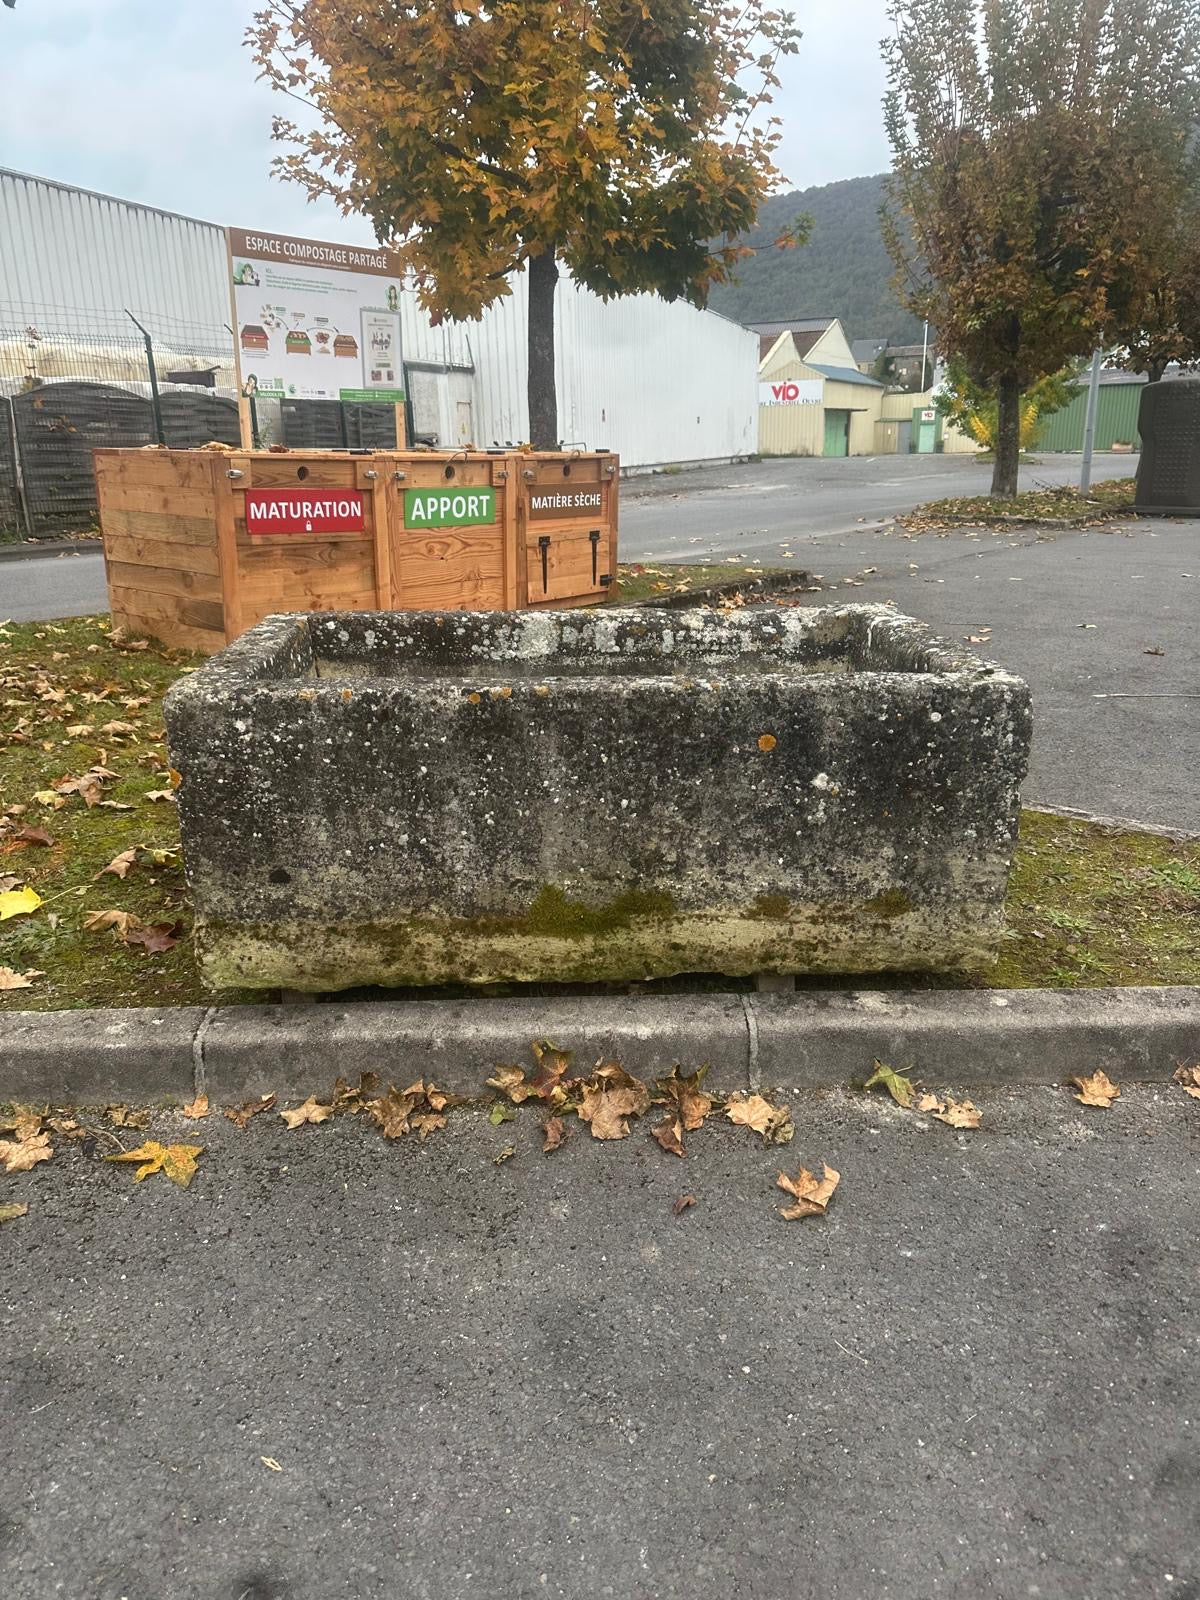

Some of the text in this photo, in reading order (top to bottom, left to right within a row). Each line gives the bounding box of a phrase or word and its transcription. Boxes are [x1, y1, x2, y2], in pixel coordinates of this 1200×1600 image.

[245, 235, 281, 254] ESPACE
[283, 242, 347, 264] COMPOSTAGE
[349, 252, 388, 269] PARTAGÉ
[249, 500, 361, 520] MATURATION
[411, 495, 491, 521] APPORT
[531, 491, 601, 509] MATIÈRE SÈCHE
